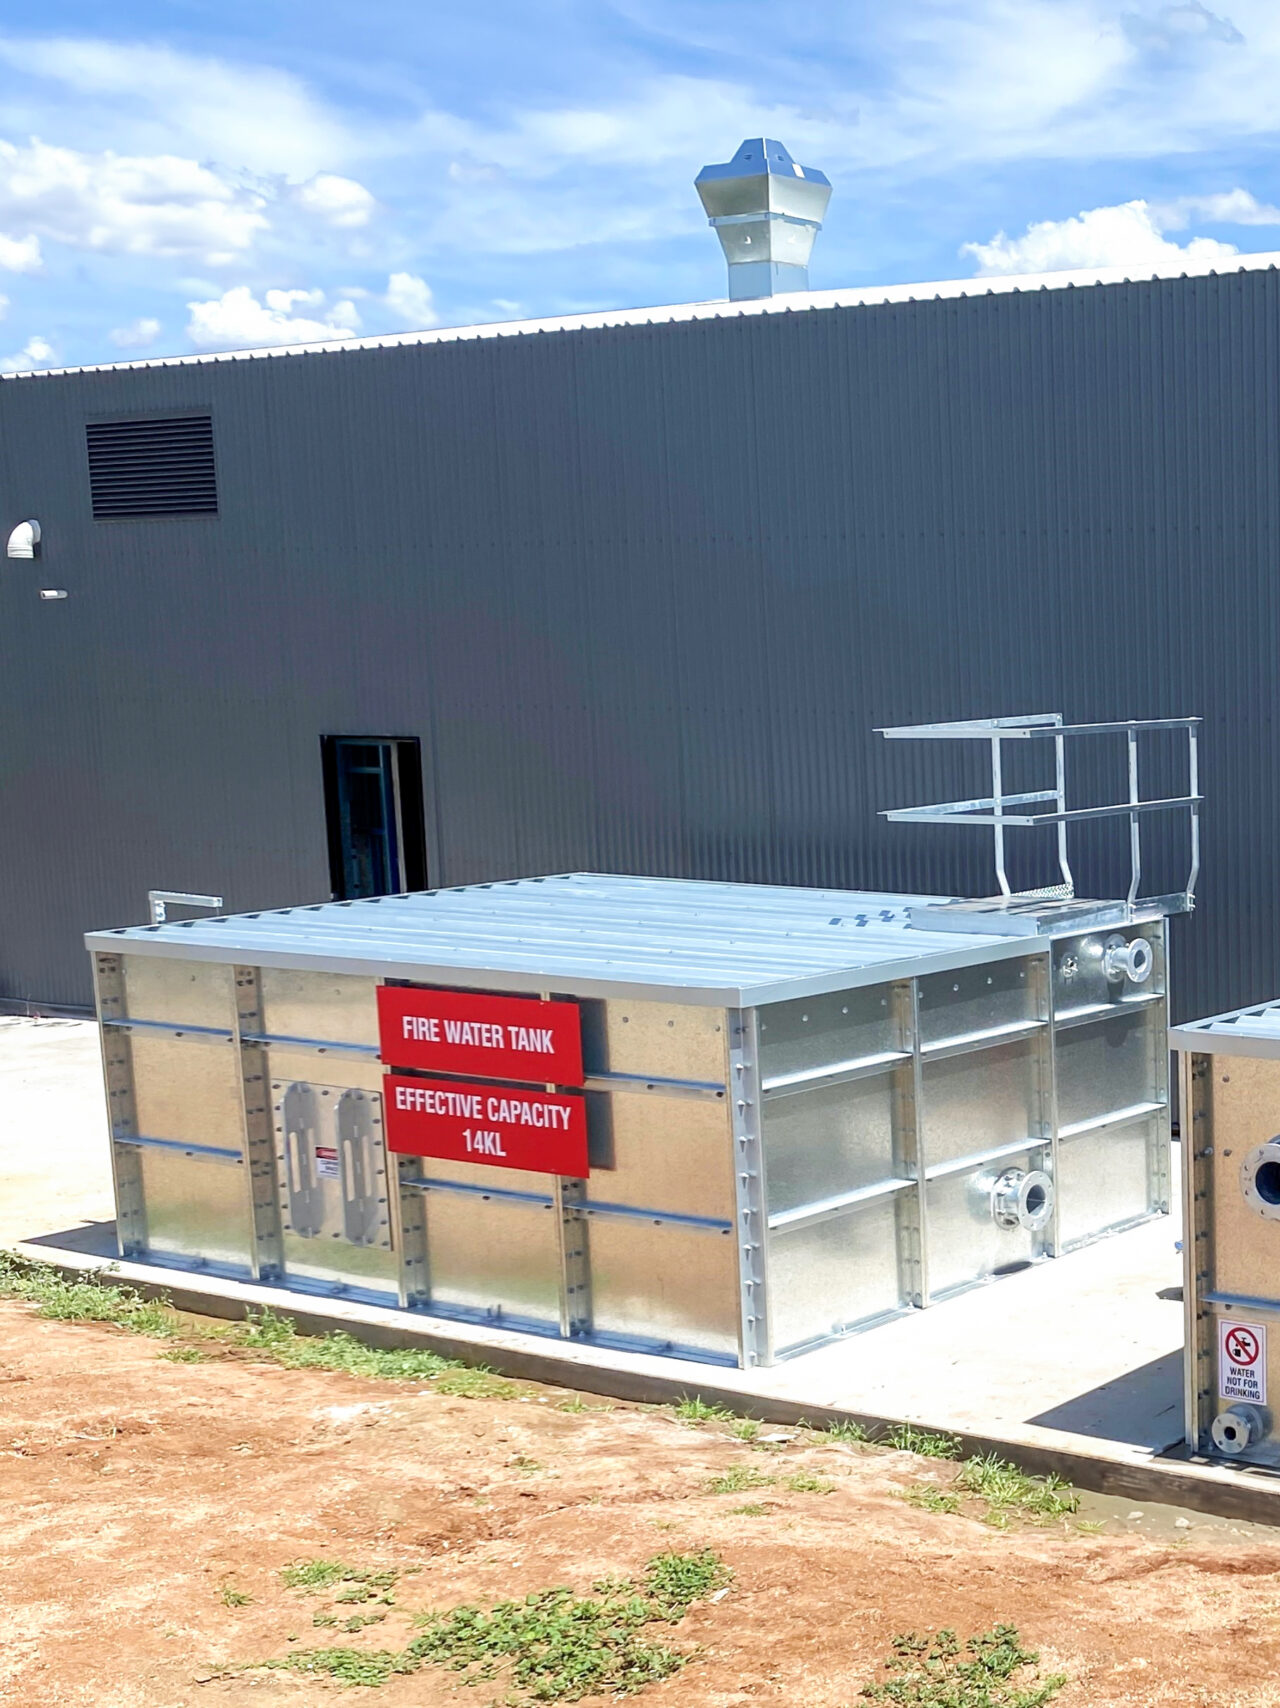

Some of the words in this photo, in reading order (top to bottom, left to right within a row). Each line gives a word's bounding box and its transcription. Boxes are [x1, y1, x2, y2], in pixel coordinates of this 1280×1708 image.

[402, 1015, 441, 1042] FIRE
[443, 1019, 505, 1049] WATER
[507, 1025, 555, 1054] TANK
[395, 1086, 483, 1120] EFFECTIVE
[487, 1097, 571, 1130] CAPACITY
[462, 1129, 507, 1157] 14KL
[1229, 1366, 1255, 1378] WATER
[1225, 1386, 1260, 1399] DRINKING
[1226, 1376, 1242, 1386] NOT
[1243, 1378, 1258, 1389] FOR
